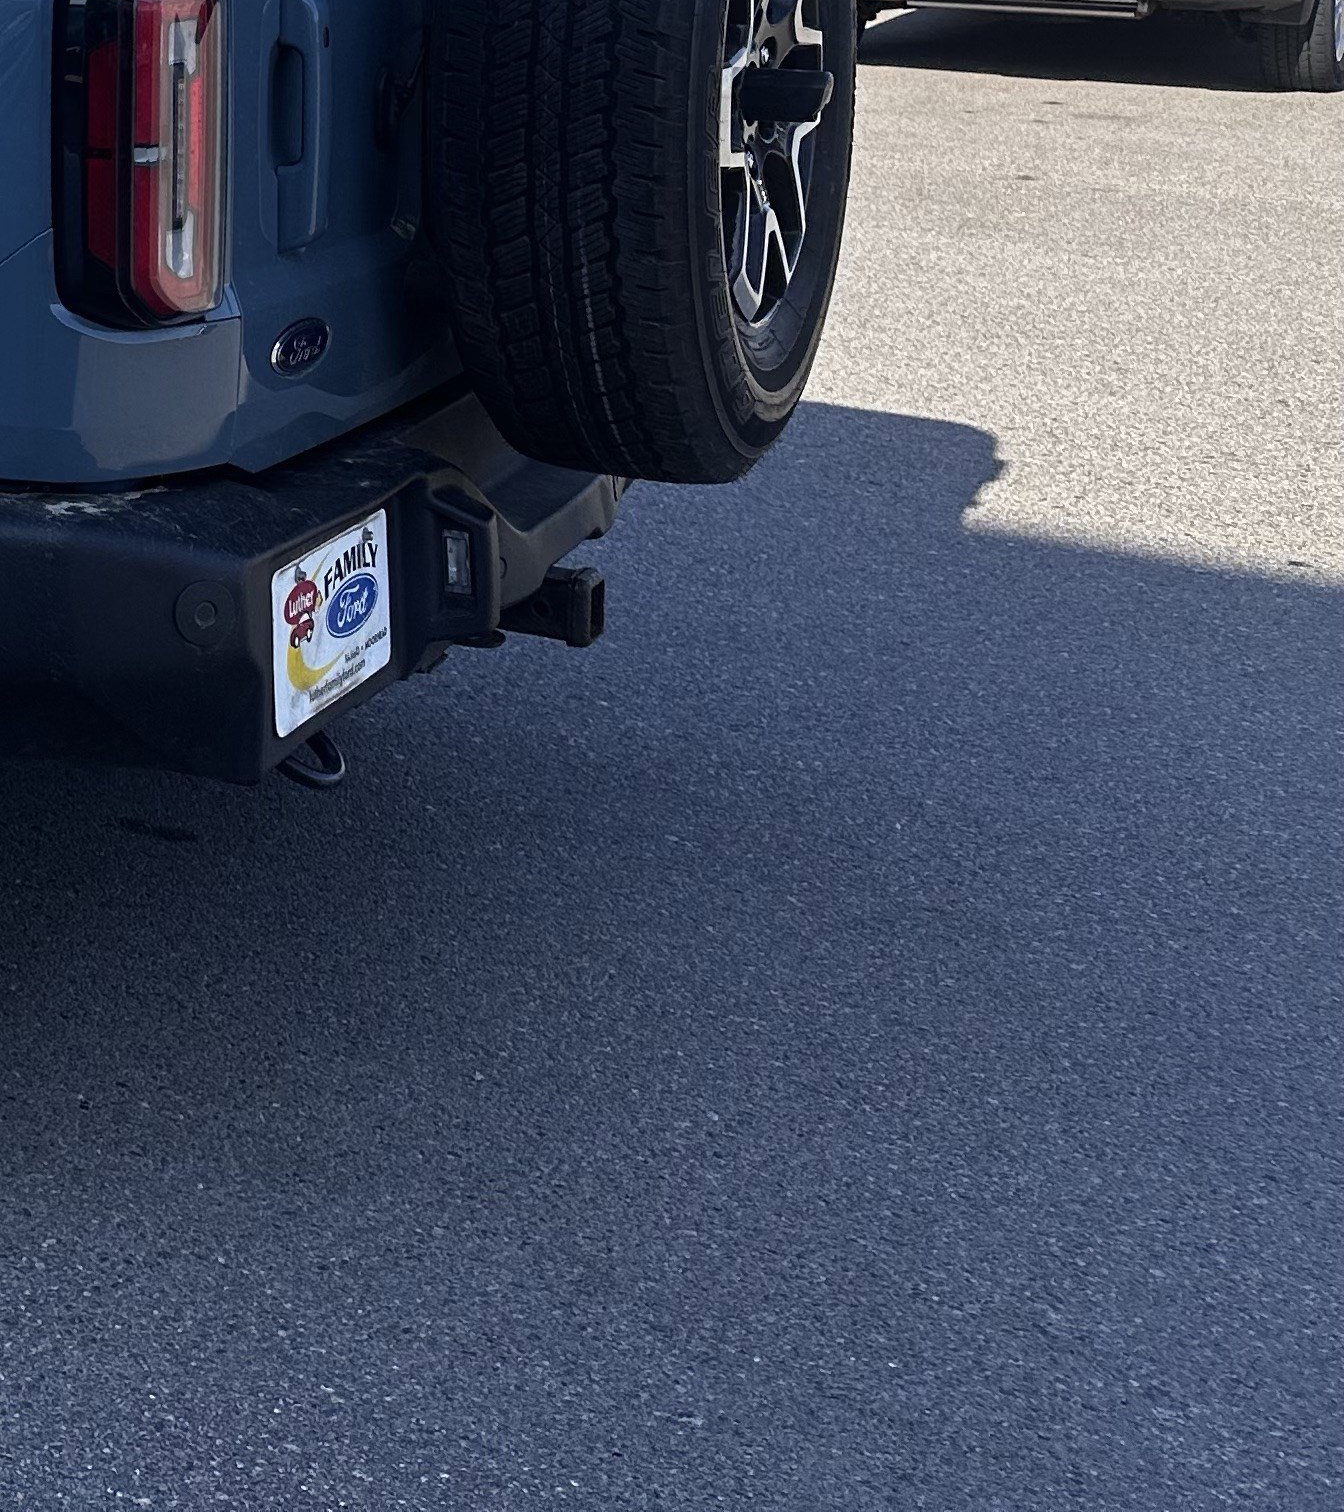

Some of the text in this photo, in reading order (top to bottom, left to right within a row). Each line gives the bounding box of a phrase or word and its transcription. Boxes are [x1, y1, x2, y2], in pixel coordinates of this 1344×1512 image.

[323, 542, 379, 601] FAMILY
[288, 589, 314, 618] Luther
[337, 584, 369, 628] Ford
